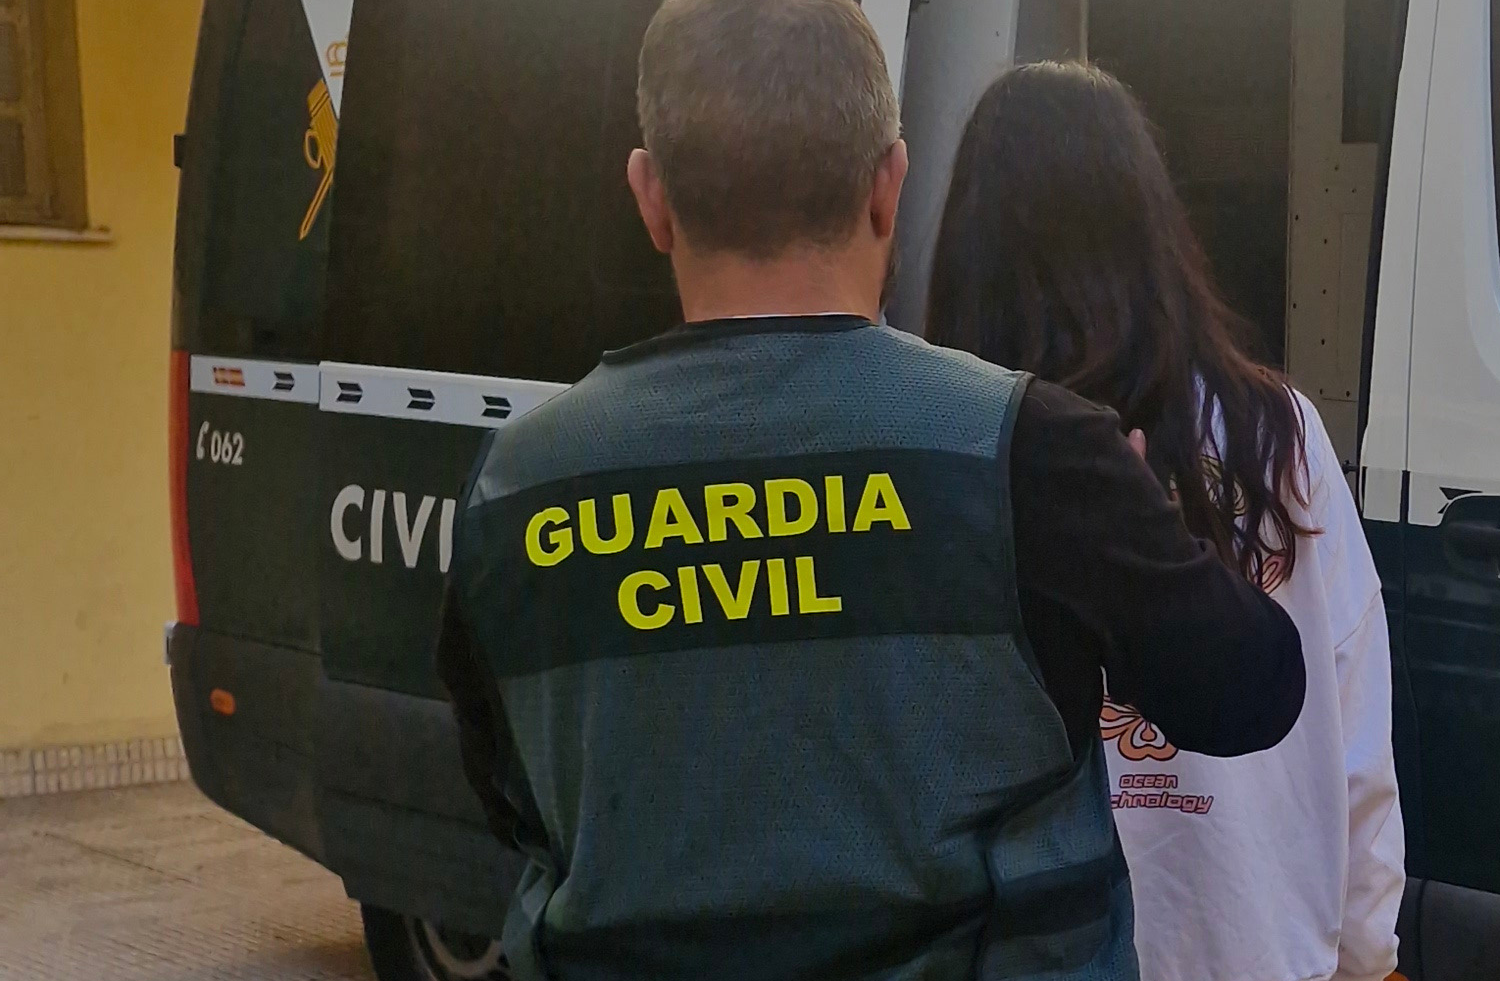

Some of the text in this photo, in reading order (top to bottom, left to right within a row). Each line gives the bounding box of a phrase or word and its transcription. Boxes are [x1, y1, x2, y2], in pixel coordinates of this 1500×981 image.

[211, 431, 244, 465] 062
[330, 484, 457, 573] CIVI
[525, 473, 912, 567] GUARDIA
[617, 556, 843, 631] CIVIL
[1110, 791, 1214, 814] chnology
[1119, 774, 1178, 789] ocean
